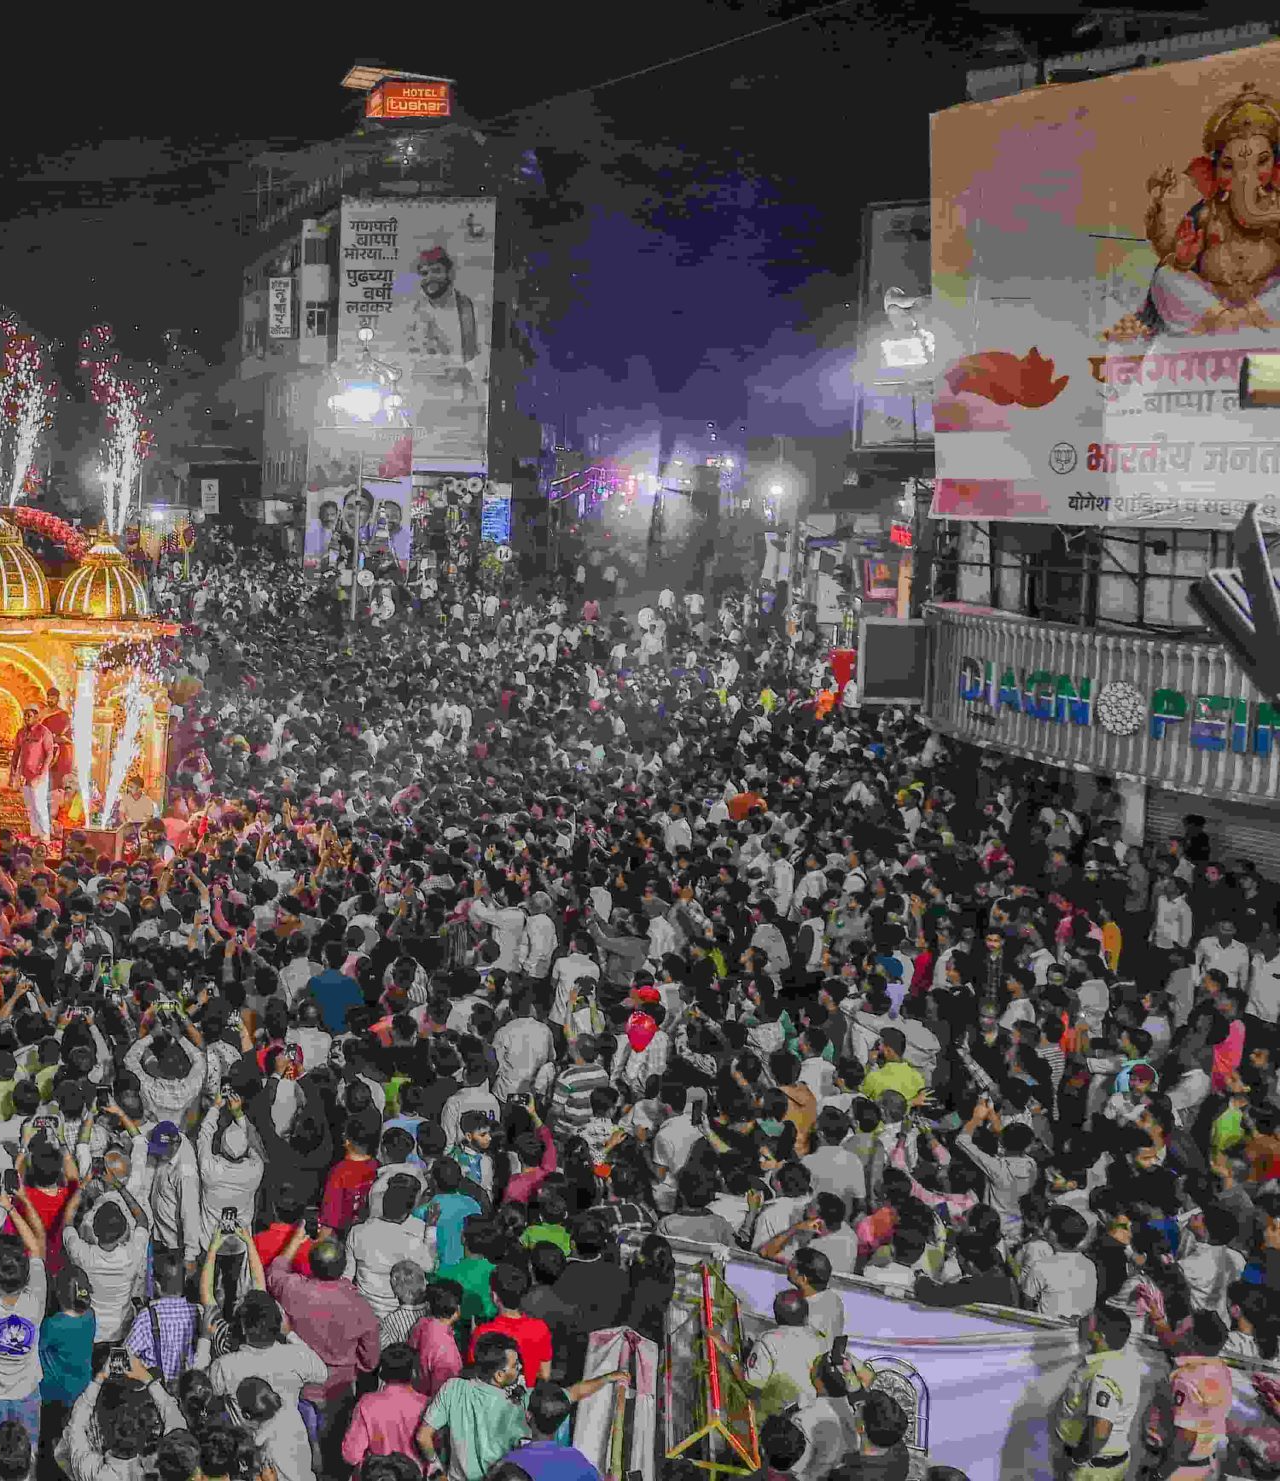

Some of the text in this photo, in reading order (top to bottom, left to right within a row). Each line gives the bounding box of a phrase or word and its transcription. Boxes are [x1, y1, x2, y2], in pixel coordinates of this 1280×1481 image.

[402, 88, 438, 97] HOTEL
[390, 98, 447, 112] tushar
[349, 217, 398, 232] गणपती
[356, 233, 398, 247] बाप्पा
[346, 269, 394, 287] पुढच्या
[363, 282, 393, 299] वर्षी
[345, 301, 393, 314] लवकर
[1086, 432, 1280, 474] भारतीय जनत
[1068, 491, 1109, 513] योगेश
